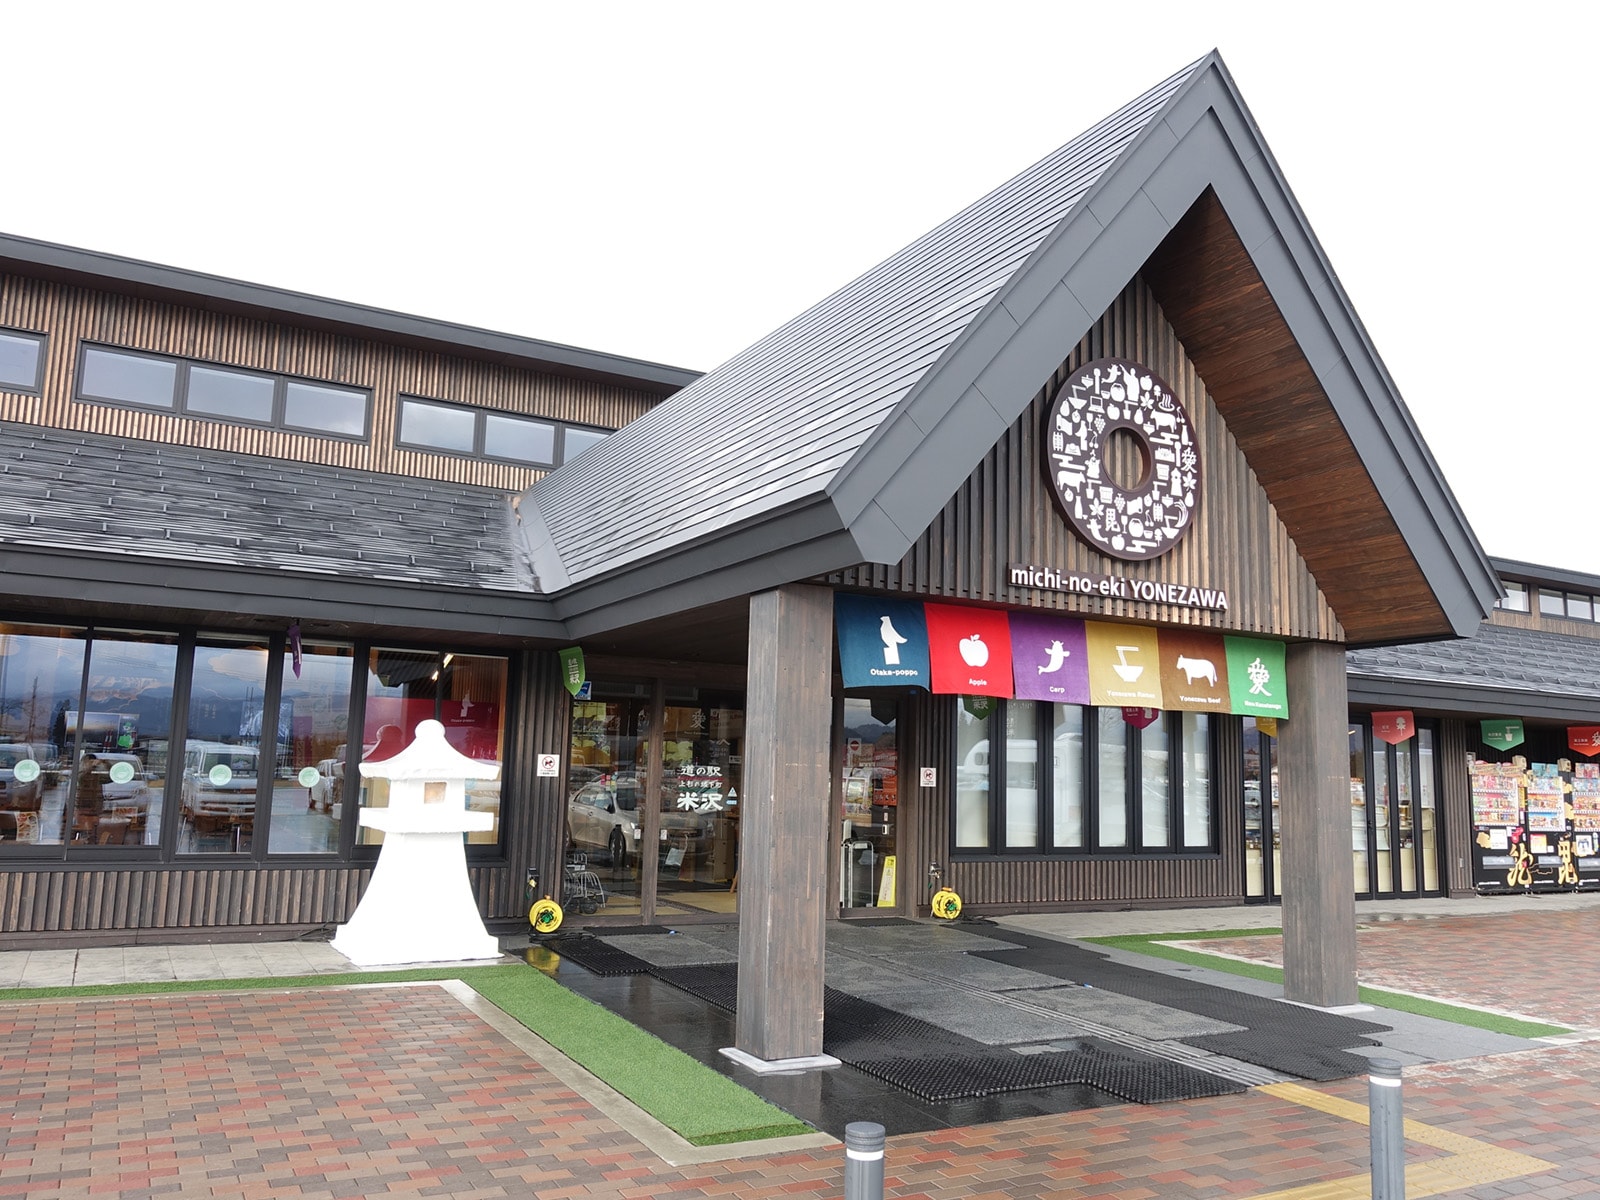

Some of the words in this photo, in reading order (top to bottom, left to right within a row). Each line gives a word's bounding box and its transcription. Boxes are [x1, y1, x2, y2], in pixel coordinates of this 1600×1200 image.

[1011, 566, 1125, 597] michi-no-eki
[1130, 579, 1228, 609] YONEZAWA
[969, 678, 987, 686] Apple
[1247, 657, 1272, 697] 愛
[1049, 686, 1065, 694] Carp
[680, 764, 722, 776] 道の駅
[677, 791, 723, 811] 米沢
